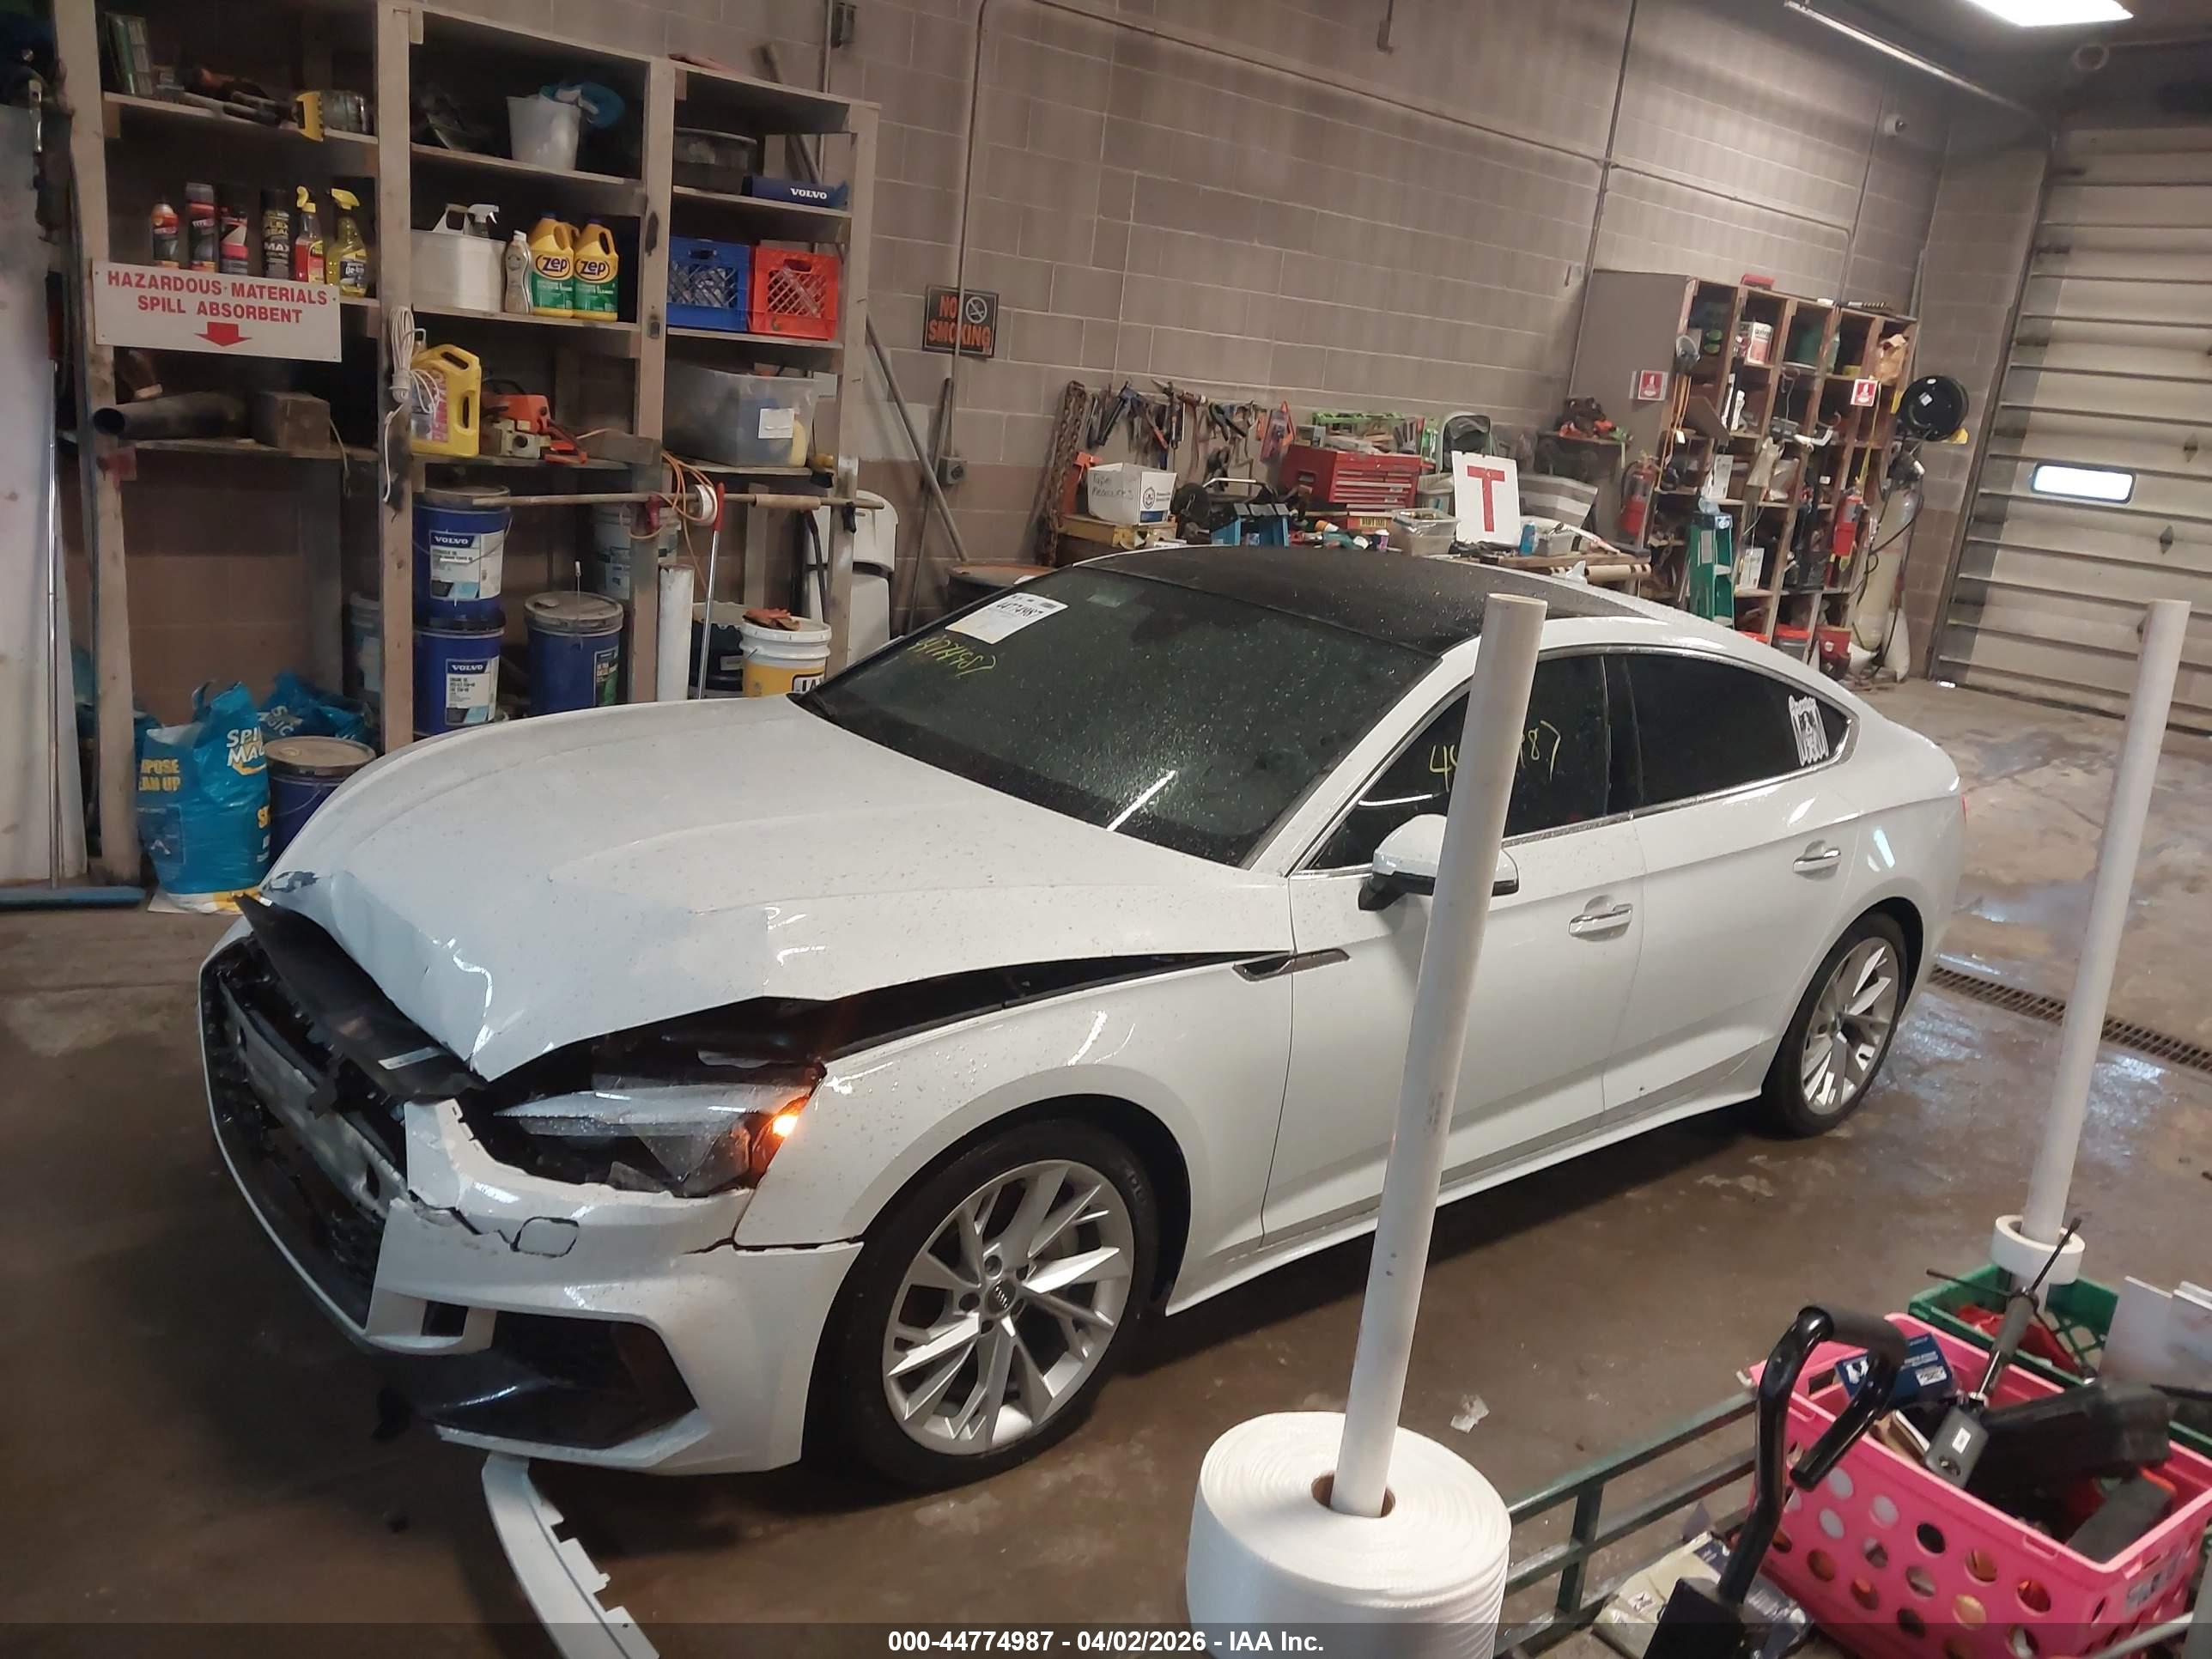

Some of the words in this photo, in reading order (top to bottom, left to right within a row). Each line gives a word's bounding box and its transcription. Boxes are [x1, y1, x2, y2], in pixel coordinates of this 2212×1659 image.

[790, 187, 828, 200] VOLVO
[107, 270, 222, 295] HAZARDOUS
[231, 282, 327, 306] MATERIALS
[137, 295, 186, 313] SPILL
[197, 301, 302, 324] ABSORBENT
[939, 295, 958, 319] NO
[1467, 465, 1505, 532] T
[434, 536, 469, 544] VOLVO
